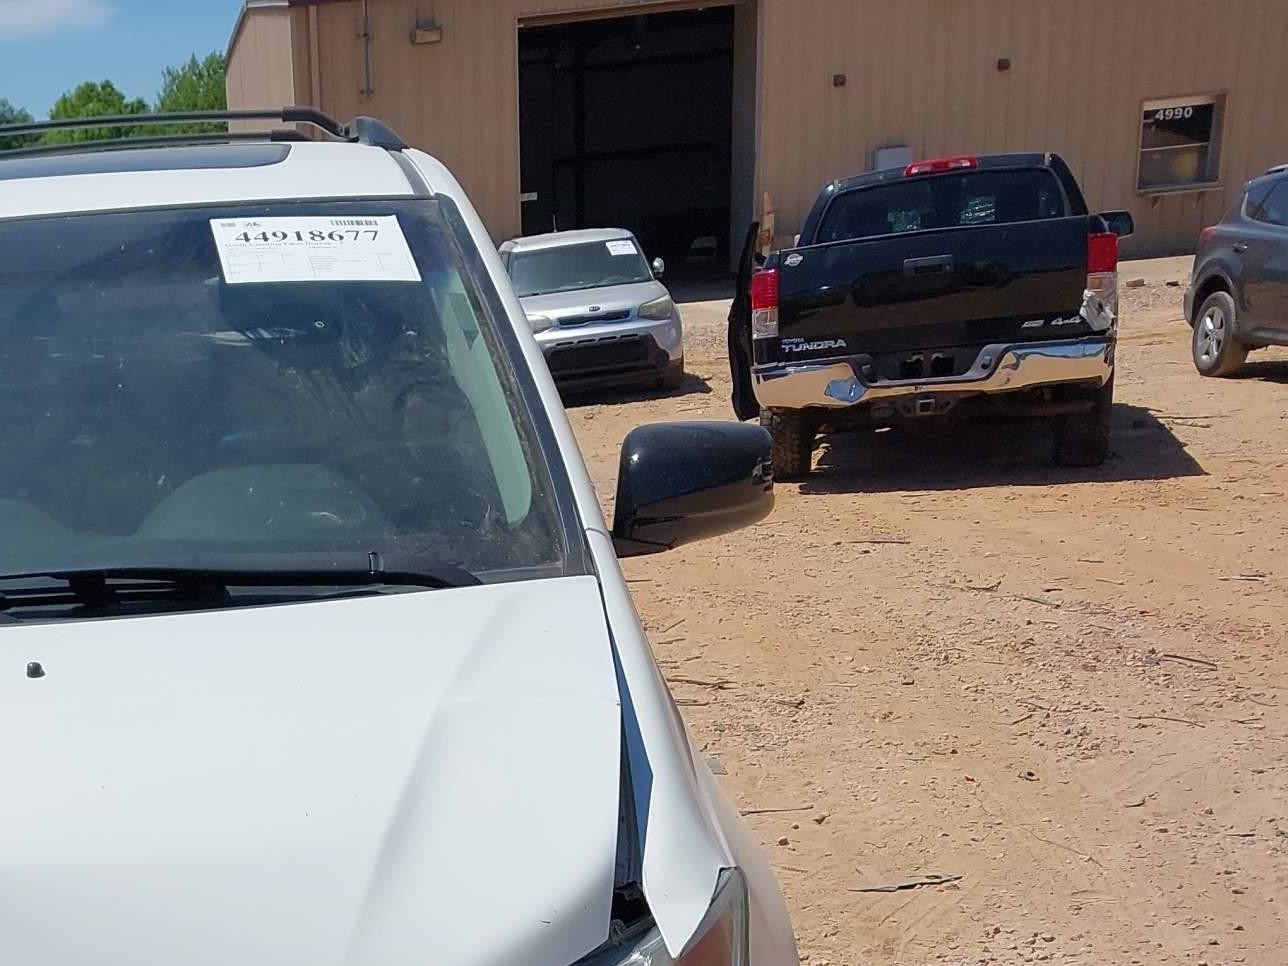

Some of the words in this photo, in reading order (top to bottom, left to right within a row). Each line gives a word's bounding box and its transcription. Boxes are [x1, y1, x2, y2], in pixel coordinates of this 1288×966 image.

[1155, 106, 1193, 121] 4990
[234, 229, 379, 243] 44918677
[781, 338, 847, 353] TUNDRA
